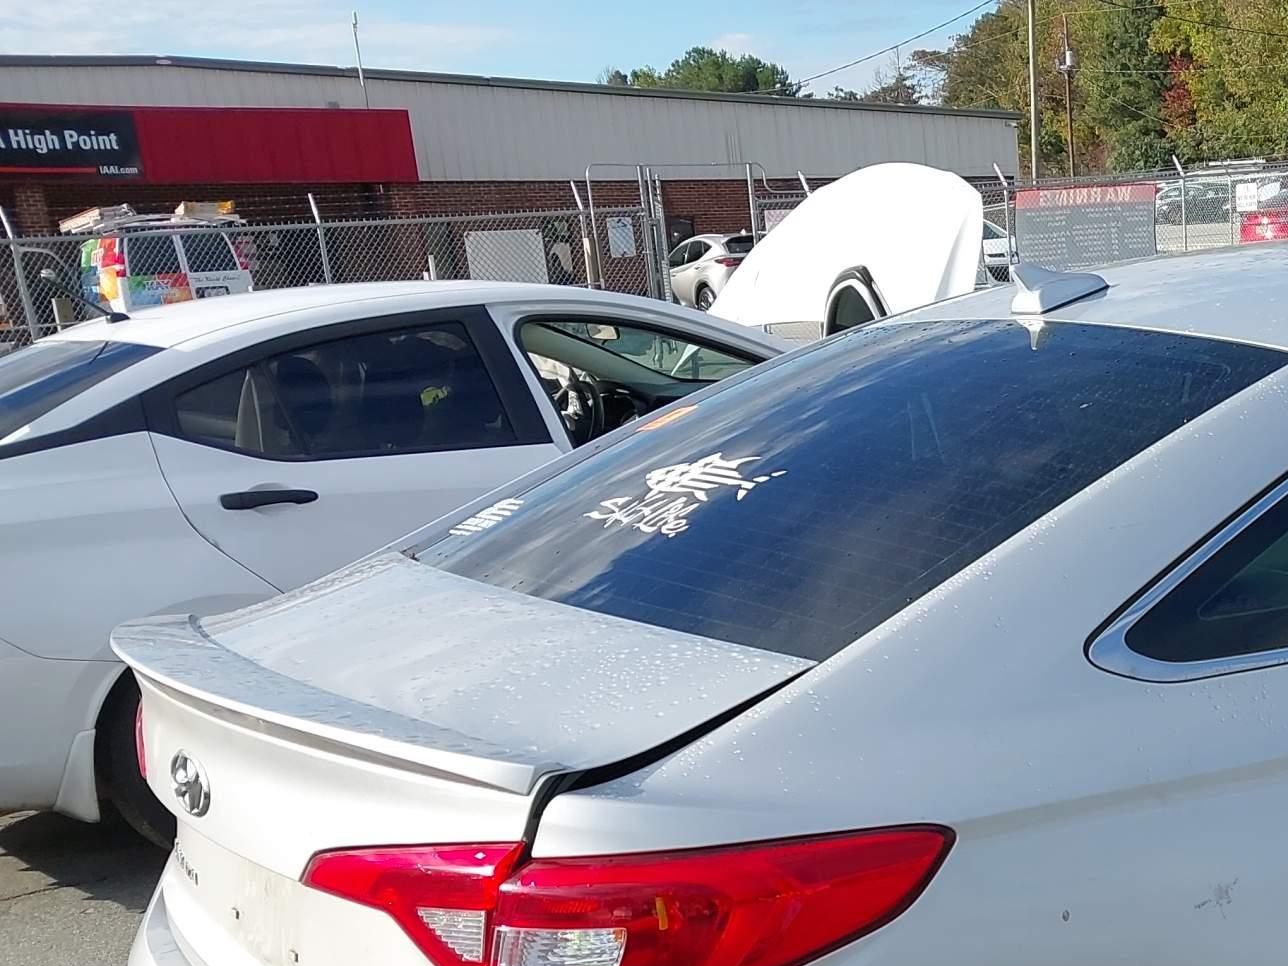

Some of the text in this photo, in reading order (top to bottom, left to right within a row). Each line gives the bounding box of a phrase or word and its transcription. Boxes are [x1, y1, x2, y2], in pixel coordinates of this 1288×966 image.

[8, 129, 59, 154] High
[64, 130, 119, 150] Point
[99, 165, 138, 174] IAAI.com
